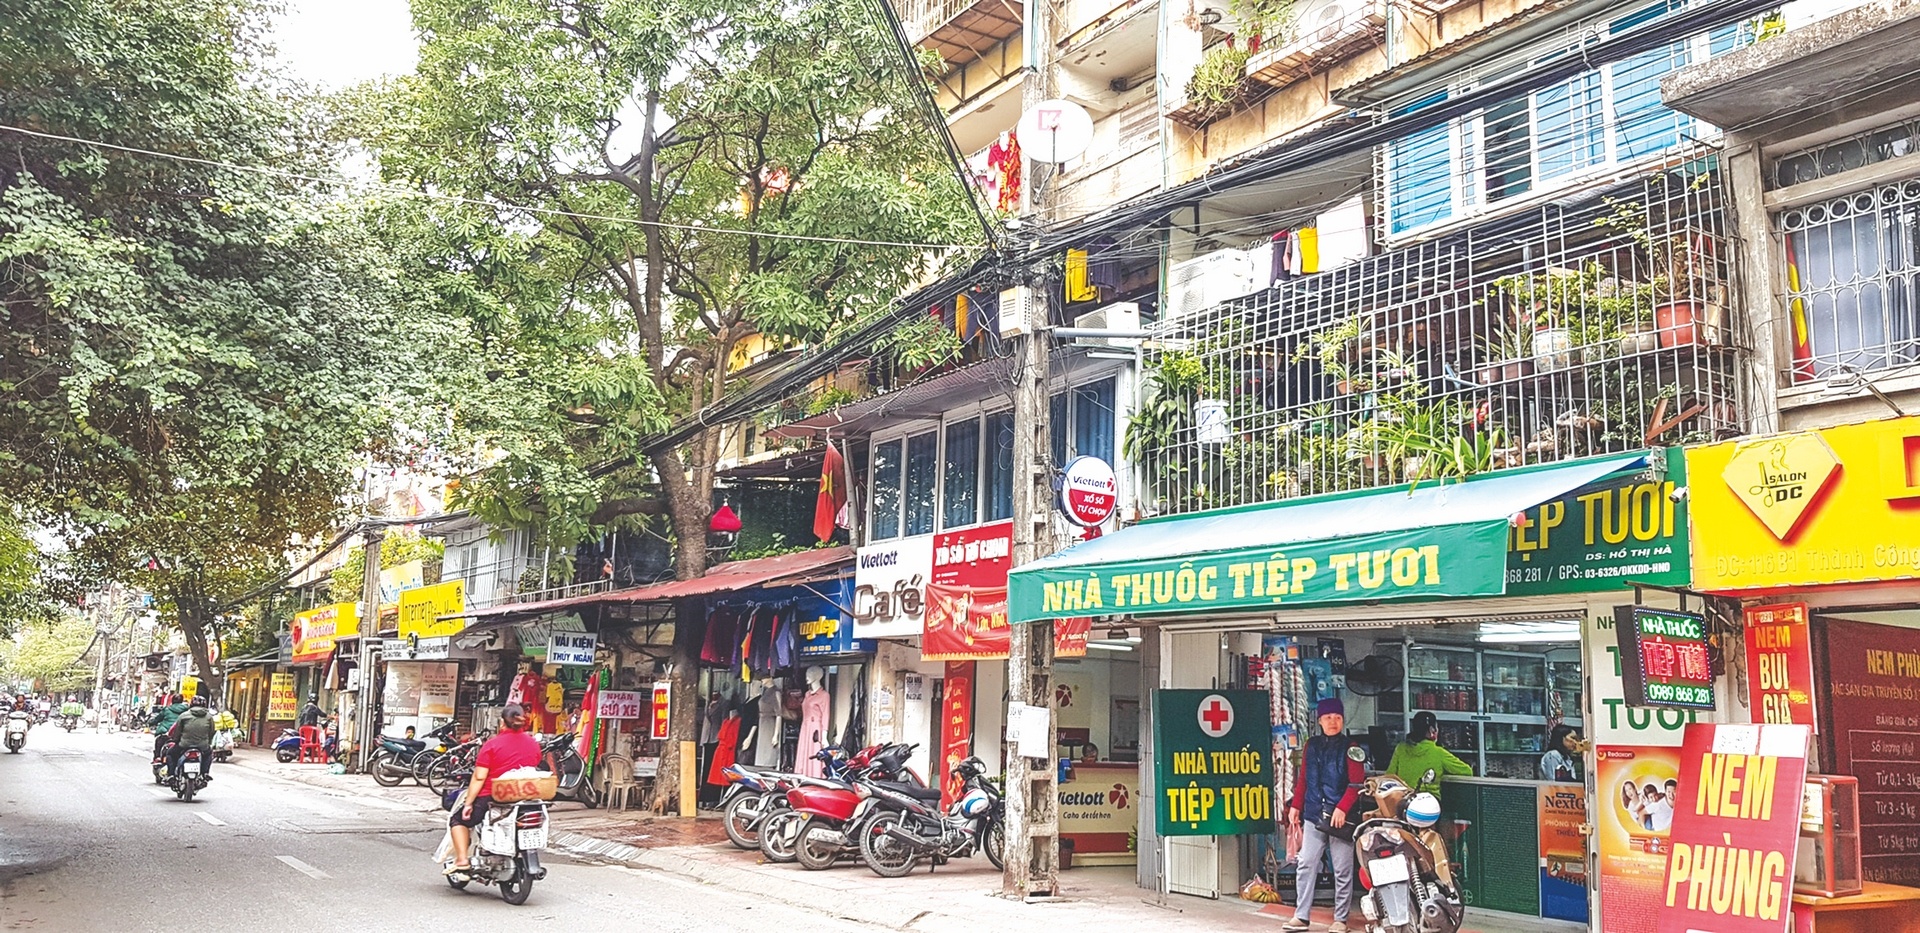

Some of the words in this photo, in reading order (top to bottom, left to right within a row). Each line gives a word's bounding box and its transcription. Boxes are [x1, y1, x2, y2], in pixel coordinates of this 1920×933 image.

[1073, 476, 1106, 488] Vietlott
[1769, 471, 1807, 484] SALON
[1775, 485, 1803, 502] DC
[860, 550, 898, 569] Vietlott
[1630, 548, 1651, 558] THỊ
[1653, 544, 1672, 555] HÀ
[1806, 546, 1865, 572] Thành
[1042, 571, 1104, 613] NHÀ
[1227, 551, 1317, 603] TIỆP
[1328, 544, 1440, 592] TƯƠI
[1524, 567, 1542, 582] 281
[1559, 564, 1583, 580] GPS:
[853, 573, 925, 624] Café
[1642, 616, 1667, 636] NHÀ
[572, 637, 594, 650] KIỆN
[1755, 625, 1791, 648] NEM
[1643, 635, 1675, 684] TIỆP
[1758, 647, 1789, 690] BÙI
[1866, 648, 1895, 676] NEM
[1648, 684, 1674, 701] 0989
[1675, 686, 1694, 703] 868
[1694, 687, 1710, 704] 281
[623, 704, 637, 716] XE
[1871, 740, 1881, 753] Số
[1173, 747, 1207, 775] NHÀ
[1210, 743, 1261, 774] THUỐC
[1695, 752, 1778, 821] NEM
[1876, 770, 1888, 786] Từ
[1166, 780, 1215, 829] TIỆP
[1220, 783, 1270, 820] TƯƠI
[1875, 800, 1888, 815] Từ
[1888, 801, 1894, 815] 3
[1900, 802, 1905, 815] 5
[1906, 802, 1916, 818] kg
[1878, 834, 1888, 848] Từ
[1665, 832, 1785, 921] PHÙNG
